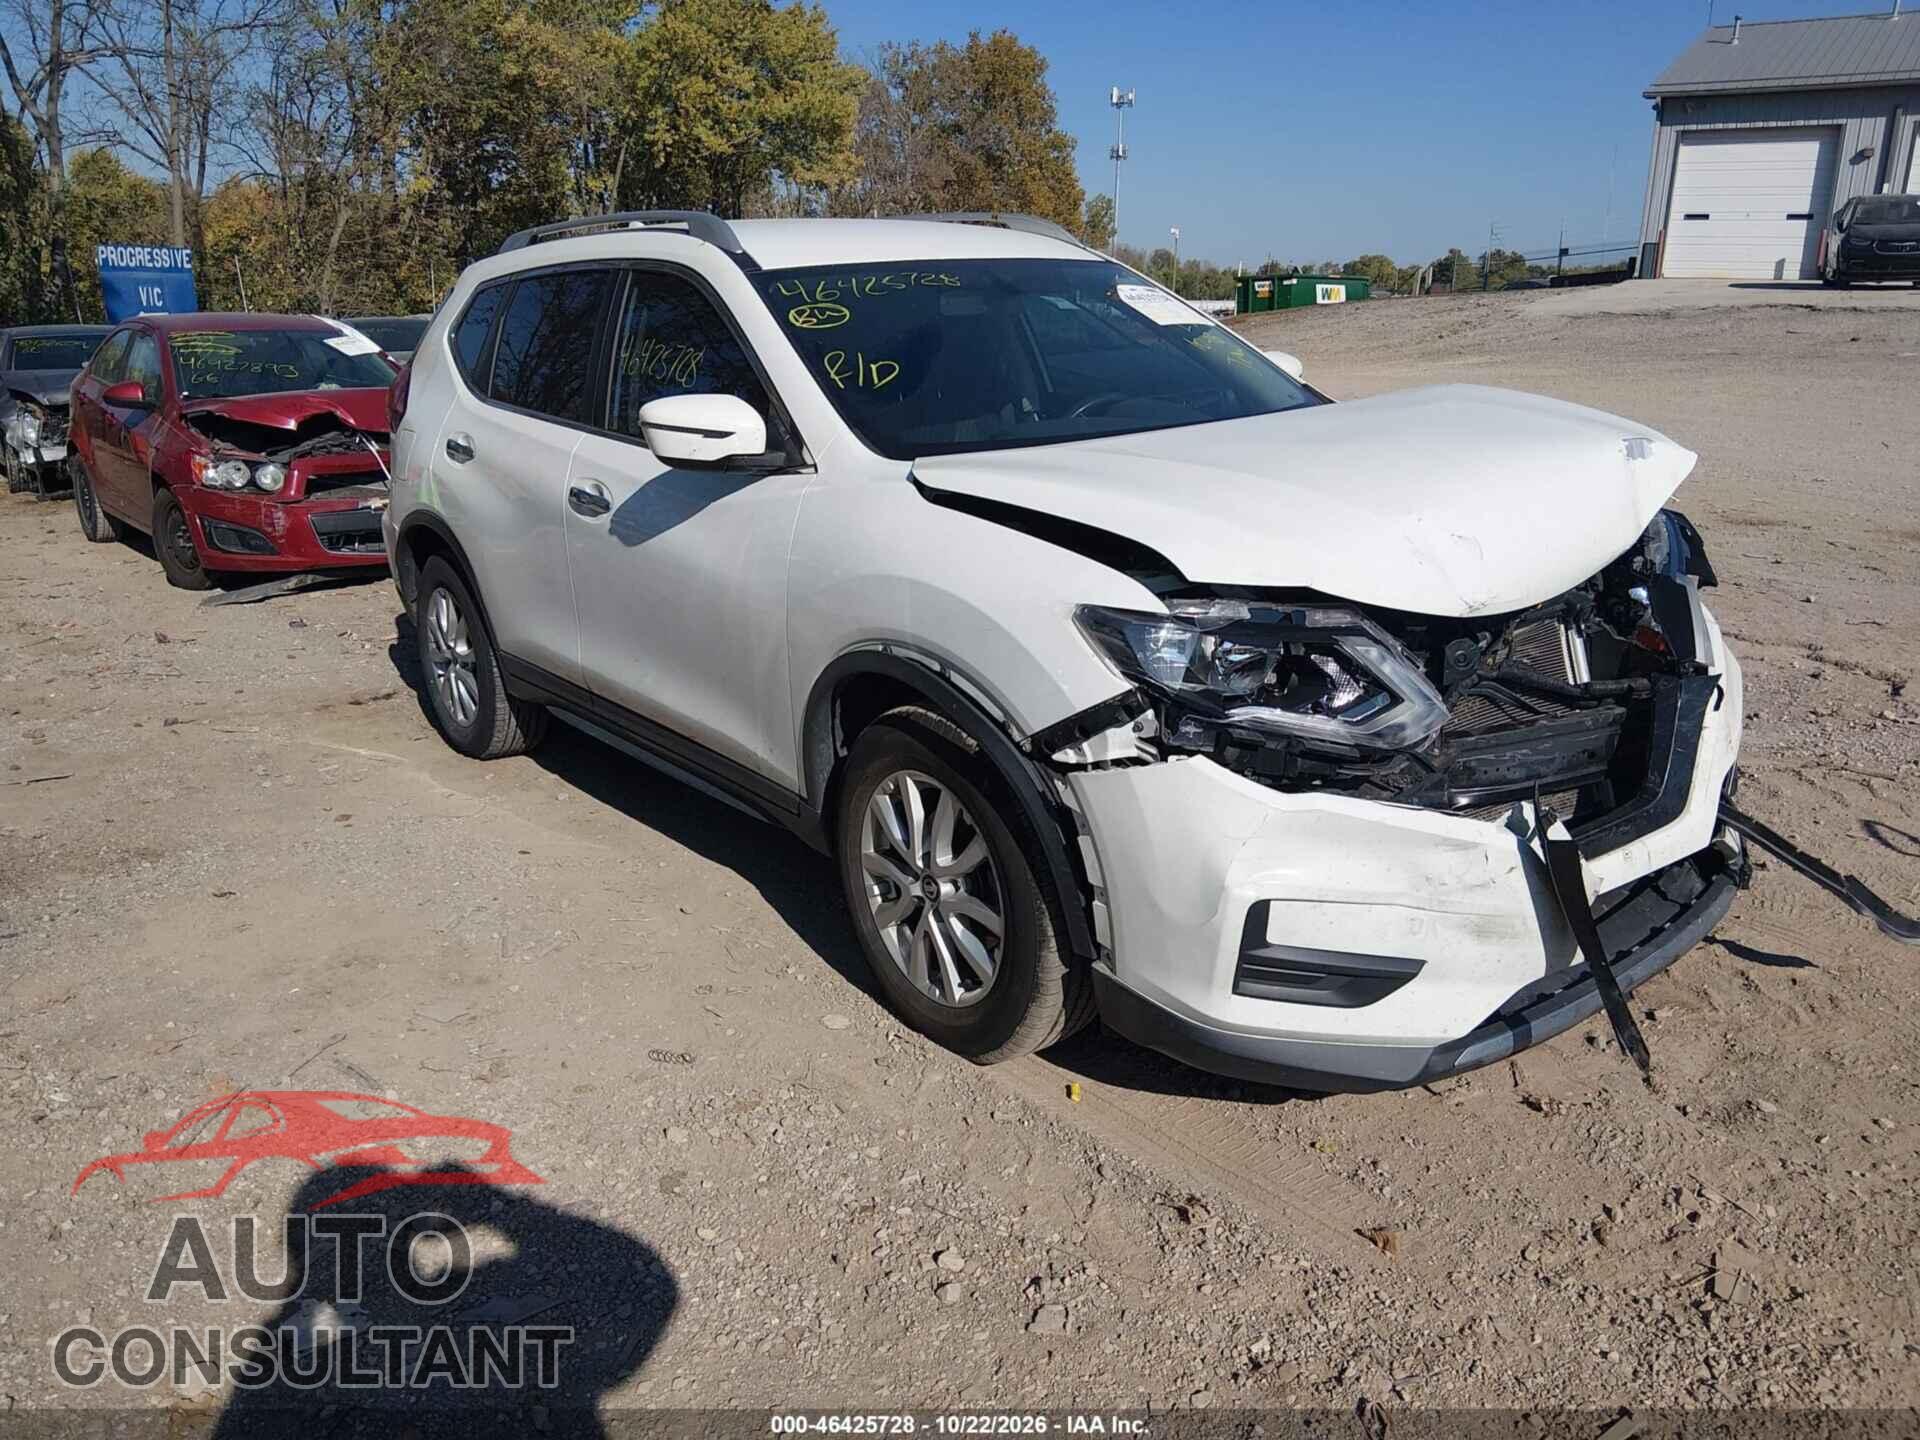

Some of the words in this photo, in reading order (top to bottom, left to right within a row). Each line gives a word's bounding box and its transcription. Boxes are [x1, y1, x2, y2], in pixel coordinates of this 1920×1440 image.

[98, 246, 192, 268] PROGRESSIVE
[138, 287, 163, 307] VIC
[777, 272, 961, 302] 46425728
[621, 336, 705, 388] 46425728
